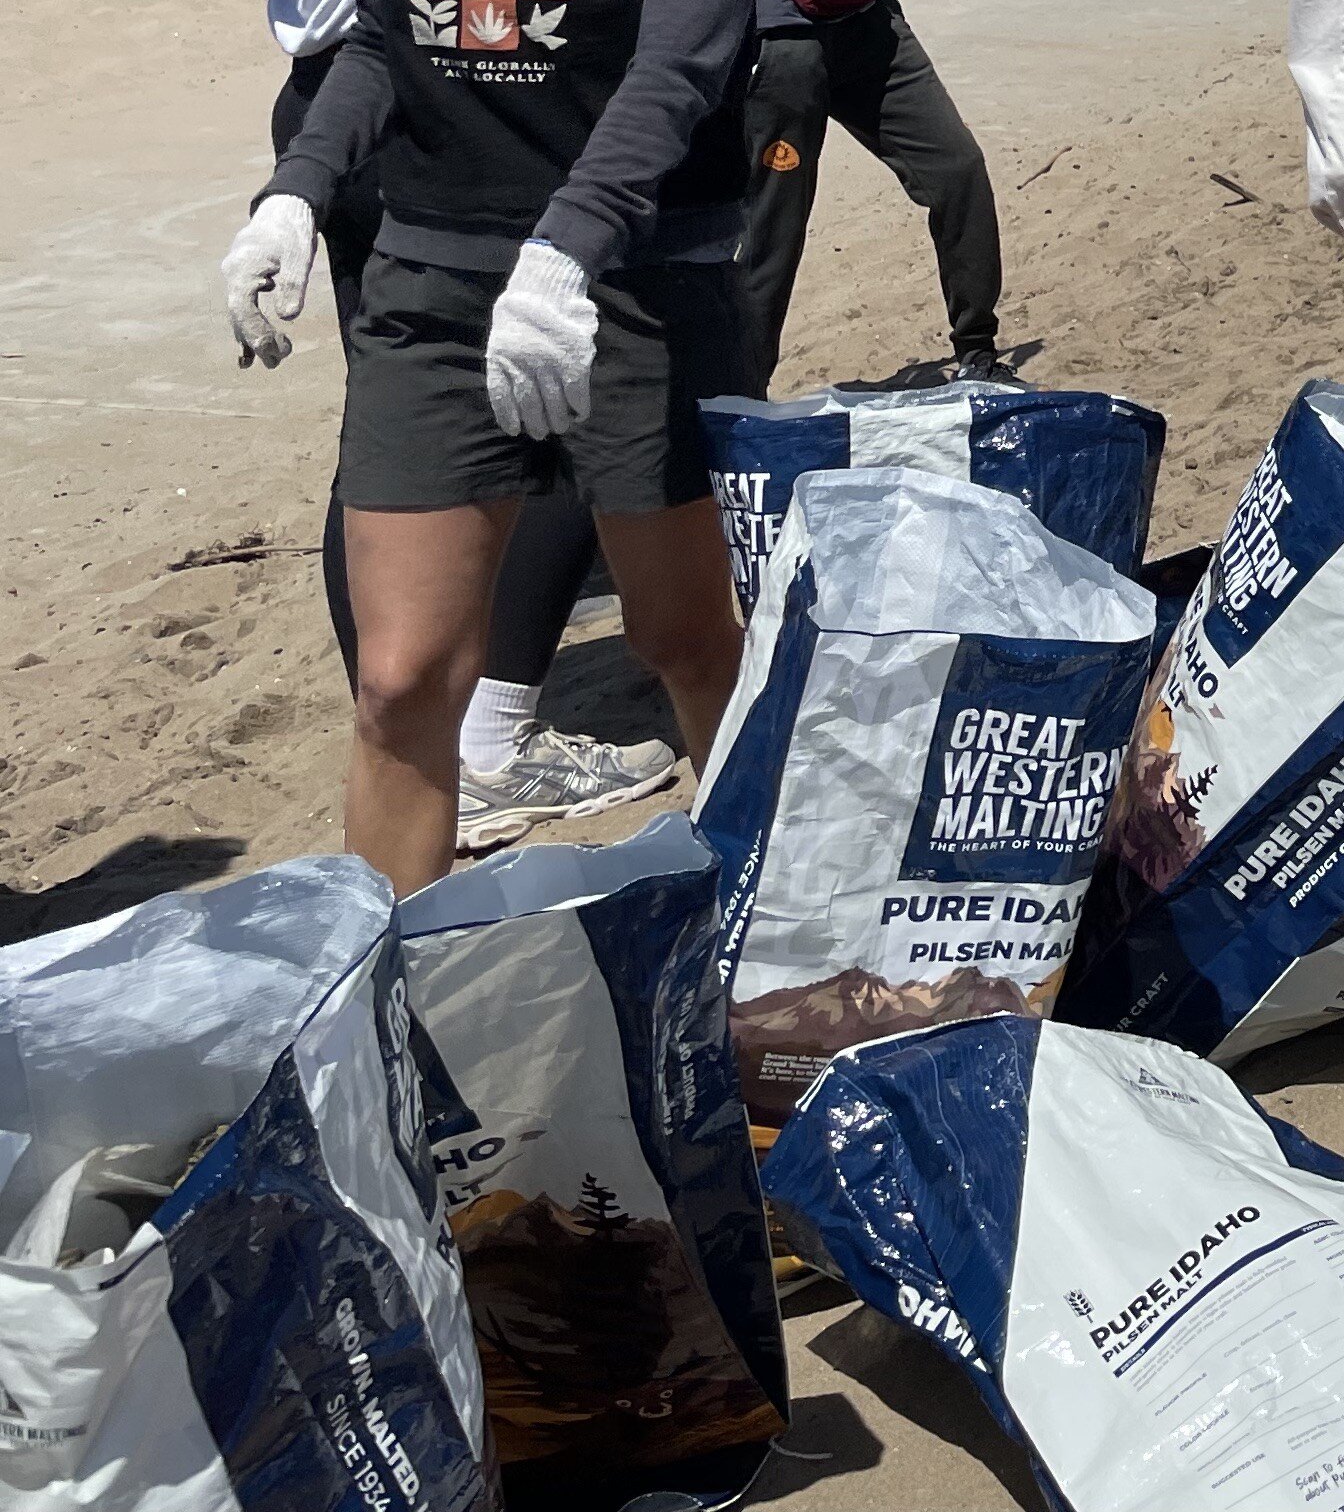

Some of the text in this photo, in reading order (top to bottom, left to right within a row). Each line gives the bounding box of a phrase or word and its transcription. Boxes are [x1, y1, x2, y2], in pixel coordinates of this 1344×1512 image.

[474, 73, 545, 82] LOCALLY
[709, 469, 771, 513] REAT
[1256, 439, 1292, 523] REAT
[1220, 512, 1258, 612] LTING
[1222, 604, 1249, 636] CRAFT
[950, 708, 1085, 759] GREAT
[944, 744, 1129, 801] WESTERN
[929, 834, 1104, 853] THE HEART OF YOUR CRA
[931, 795, 1105, 840] MALTING
[738, 829, 762, 888] NCE
[1224, 822, 1300, 900] PURE
[1272, 825, 1334, 889] PILSEN
[1289, 852, 1338, 907] PRODUCT
[881, 896, 1084, 926] PURE IDA
[910, 938, 1072, 963] PILSEN MAL
[1131, 972, 1168, 1015] CRAFT
[1089, 1206, 1260, 1349] PURE IDAHO
[1102, 1309, 1160, 1362] PILSEN
[1161, 1268, 1202, 1310] MALT
[336, 1297, 420, 1504] GROWN. MALTED.
[327, 1394, 391, 1512] SINCE 1934
[1296, 1471, 1320, 1490] Scan
[1305, 1480, 1330, 1501] about
